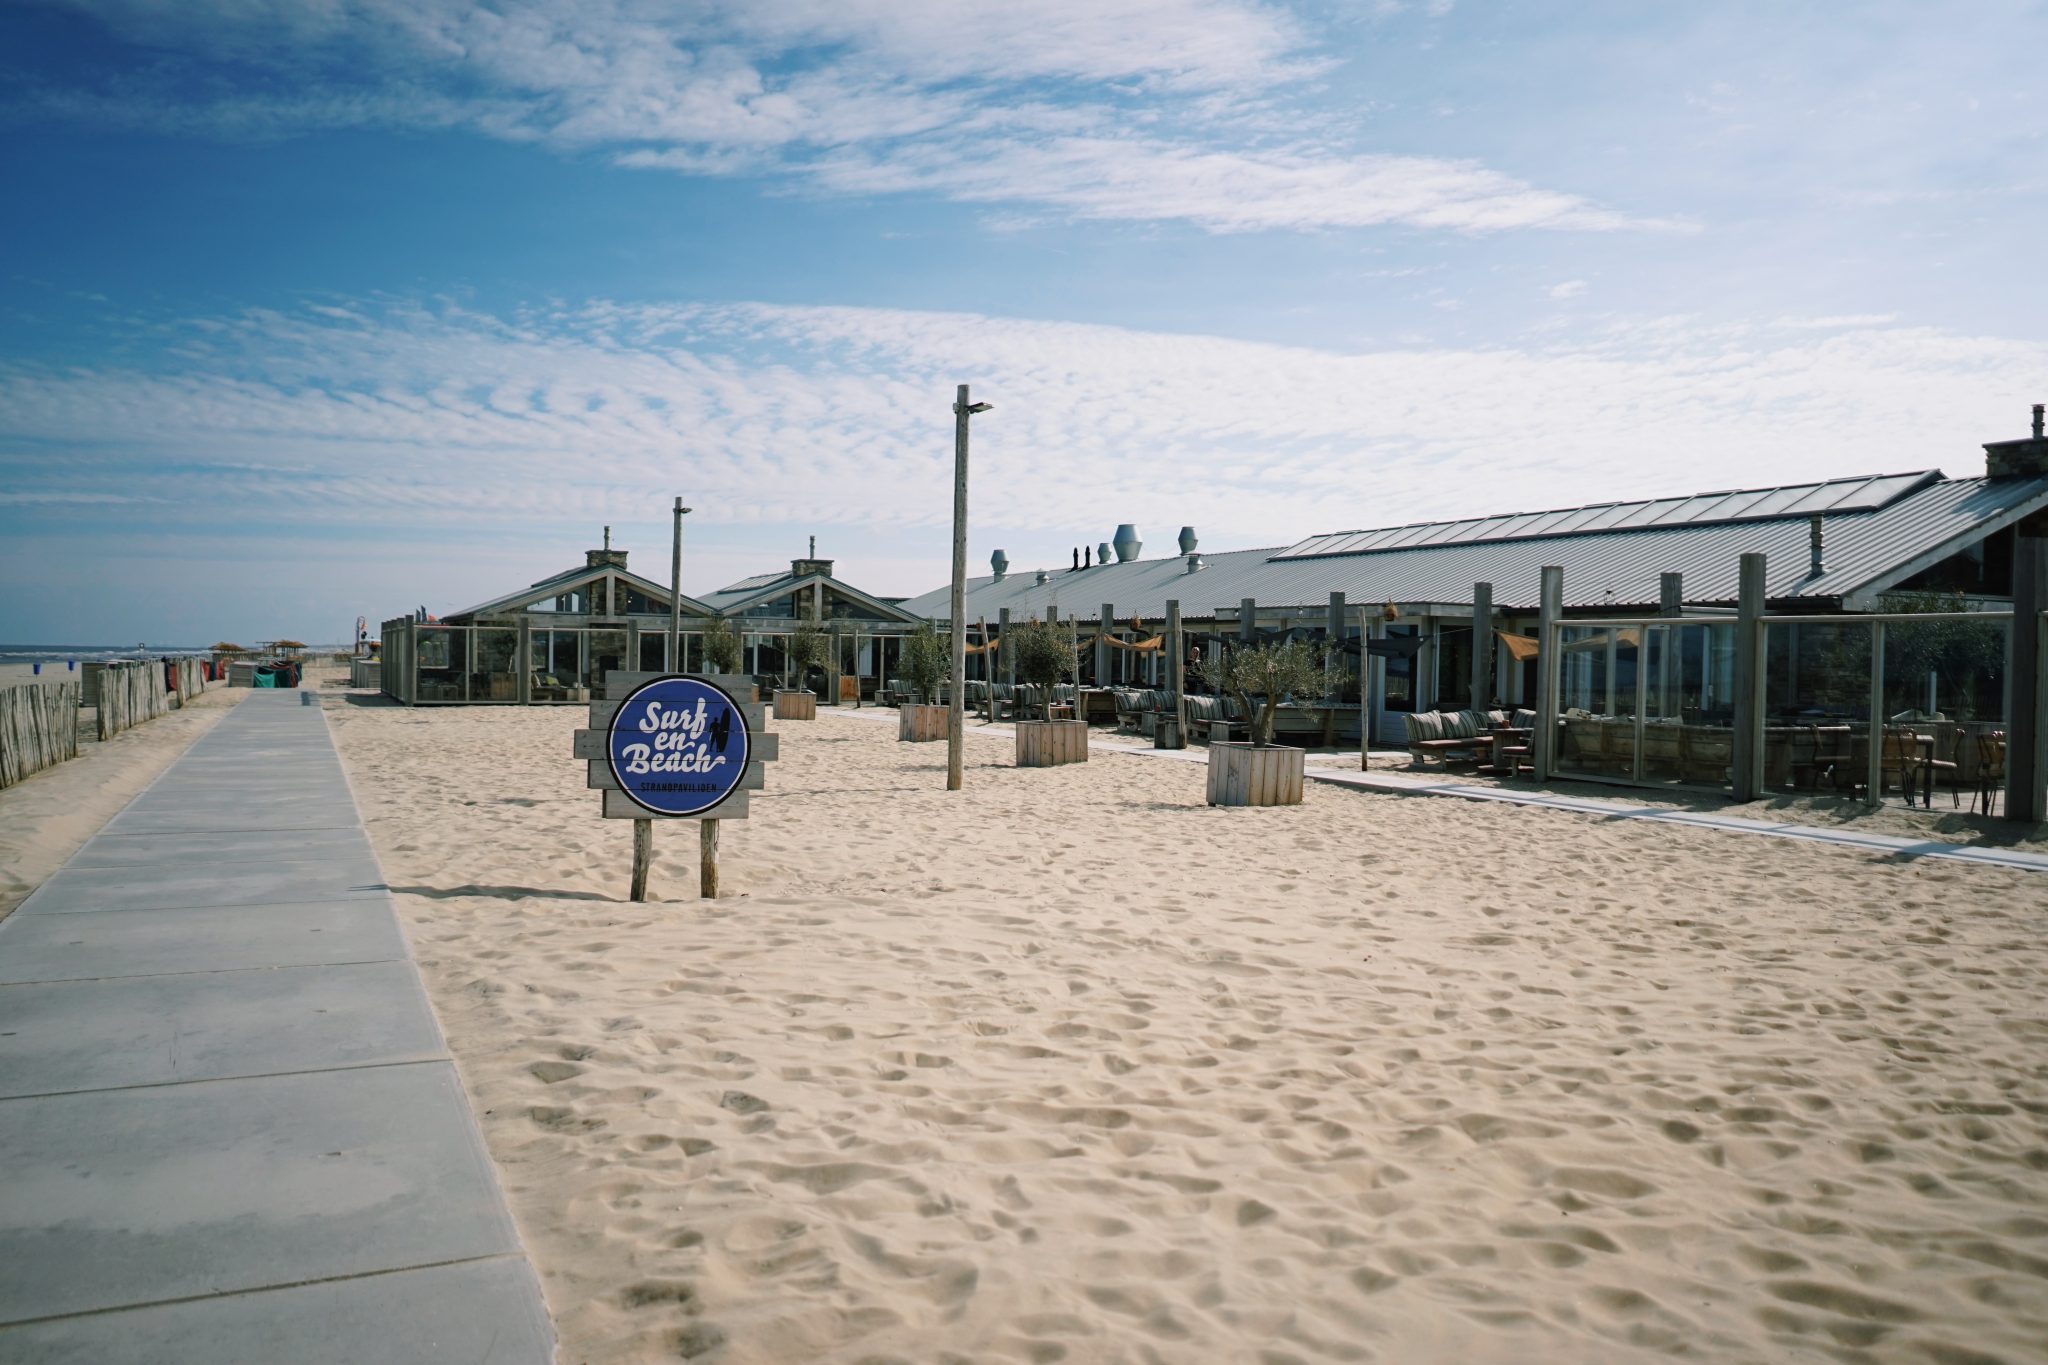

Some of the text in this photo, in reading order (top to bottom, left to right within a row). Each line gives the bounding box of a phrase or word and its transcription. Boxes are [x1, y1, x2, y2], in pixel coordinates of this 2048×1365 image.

[640, 697, 707, 739] Surf
[655, 732, 695, 750] en
[622, 743, 726, 774] Beach
